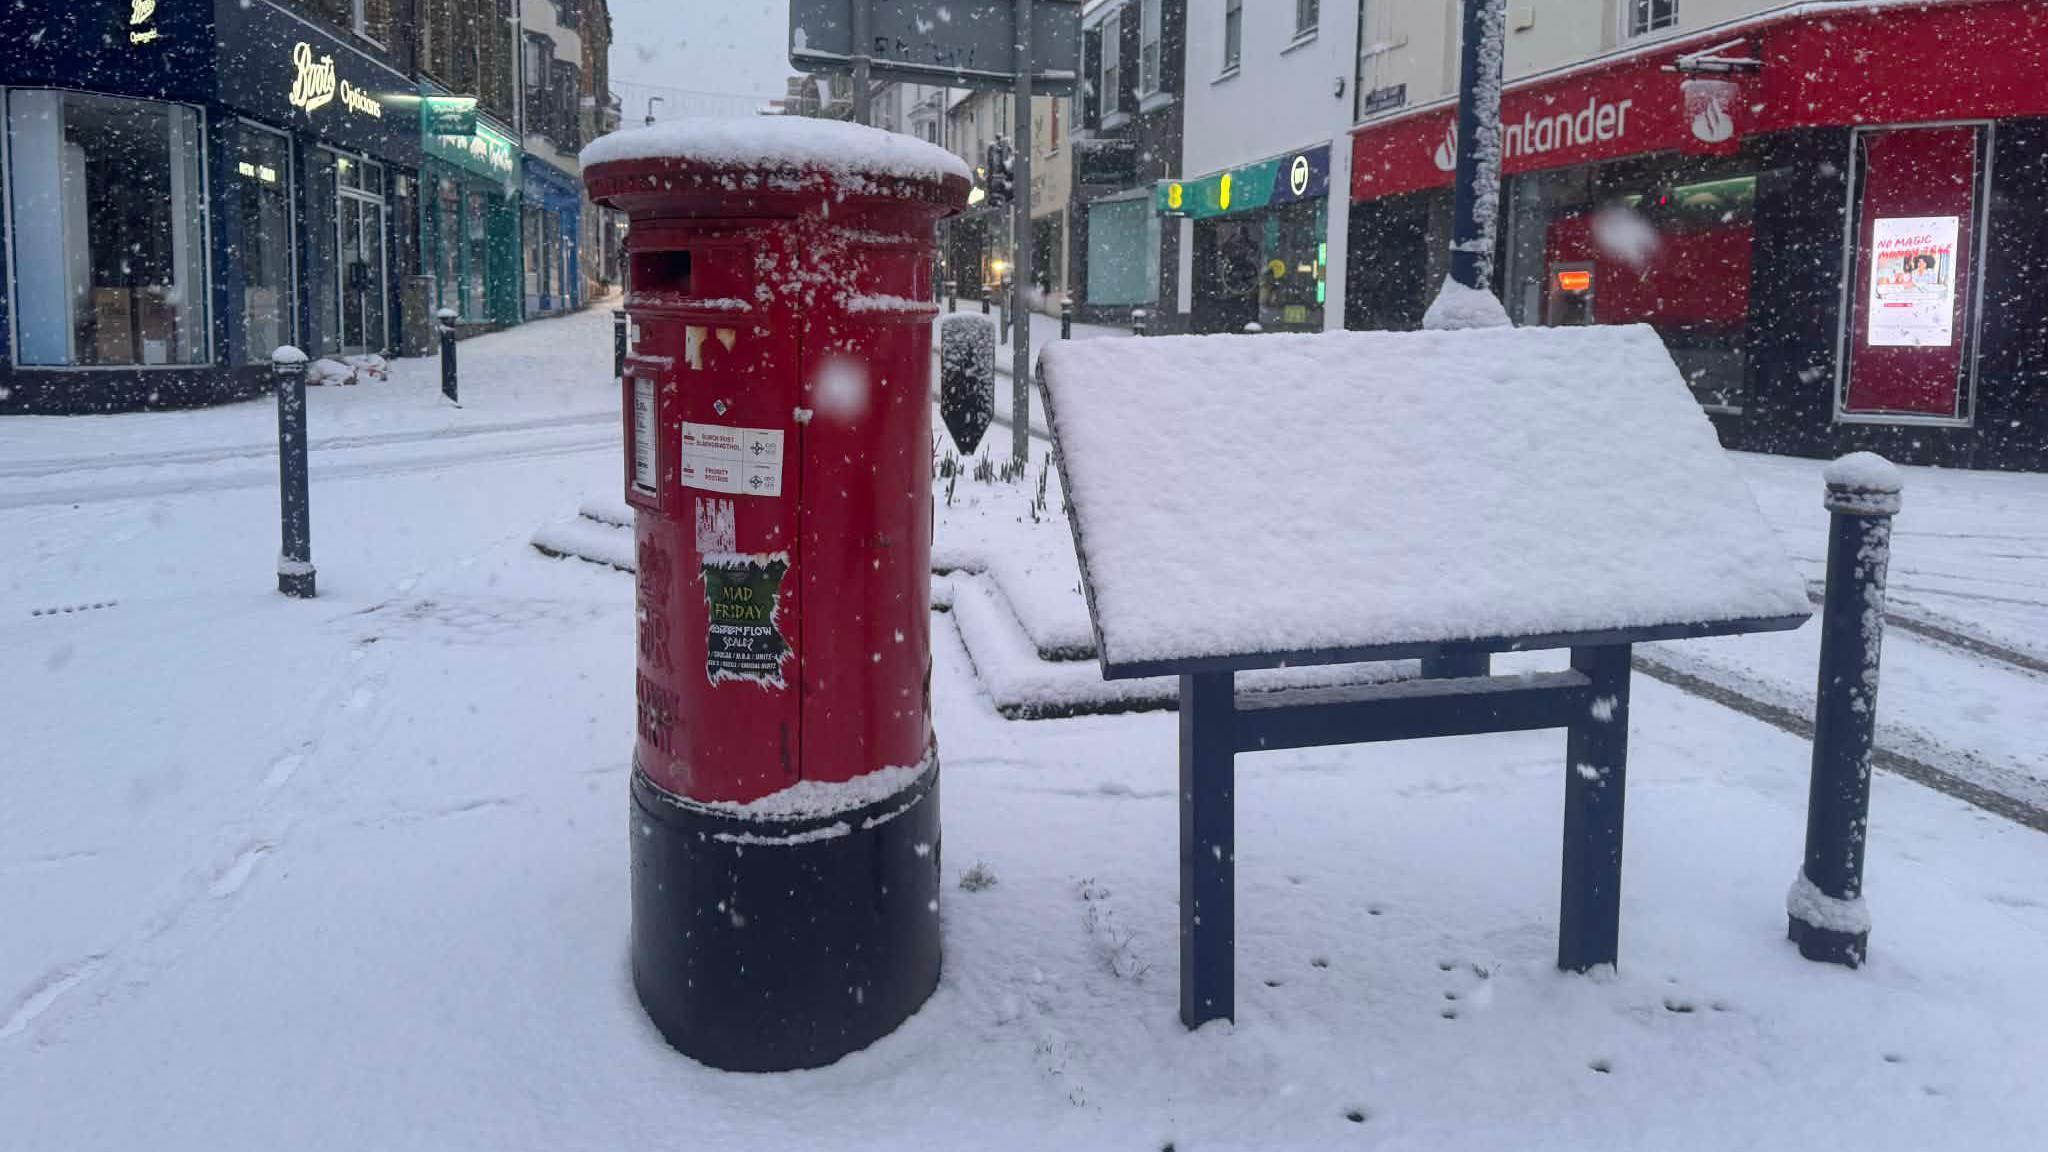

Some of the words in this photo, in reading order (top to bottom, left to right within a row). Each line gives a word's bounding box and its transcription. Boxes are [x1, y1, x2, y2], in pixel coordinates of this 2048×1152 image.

[289, 42, 335, 112] Boots
[340, 80, 381, 118] Opticians
[1500, 97, 1633, 159] ntander
[1894, 234, 1932, 248] MAGIC
[723, 586, 753, 601] MAD
[715, 603, 763, 620] FRIDAY
